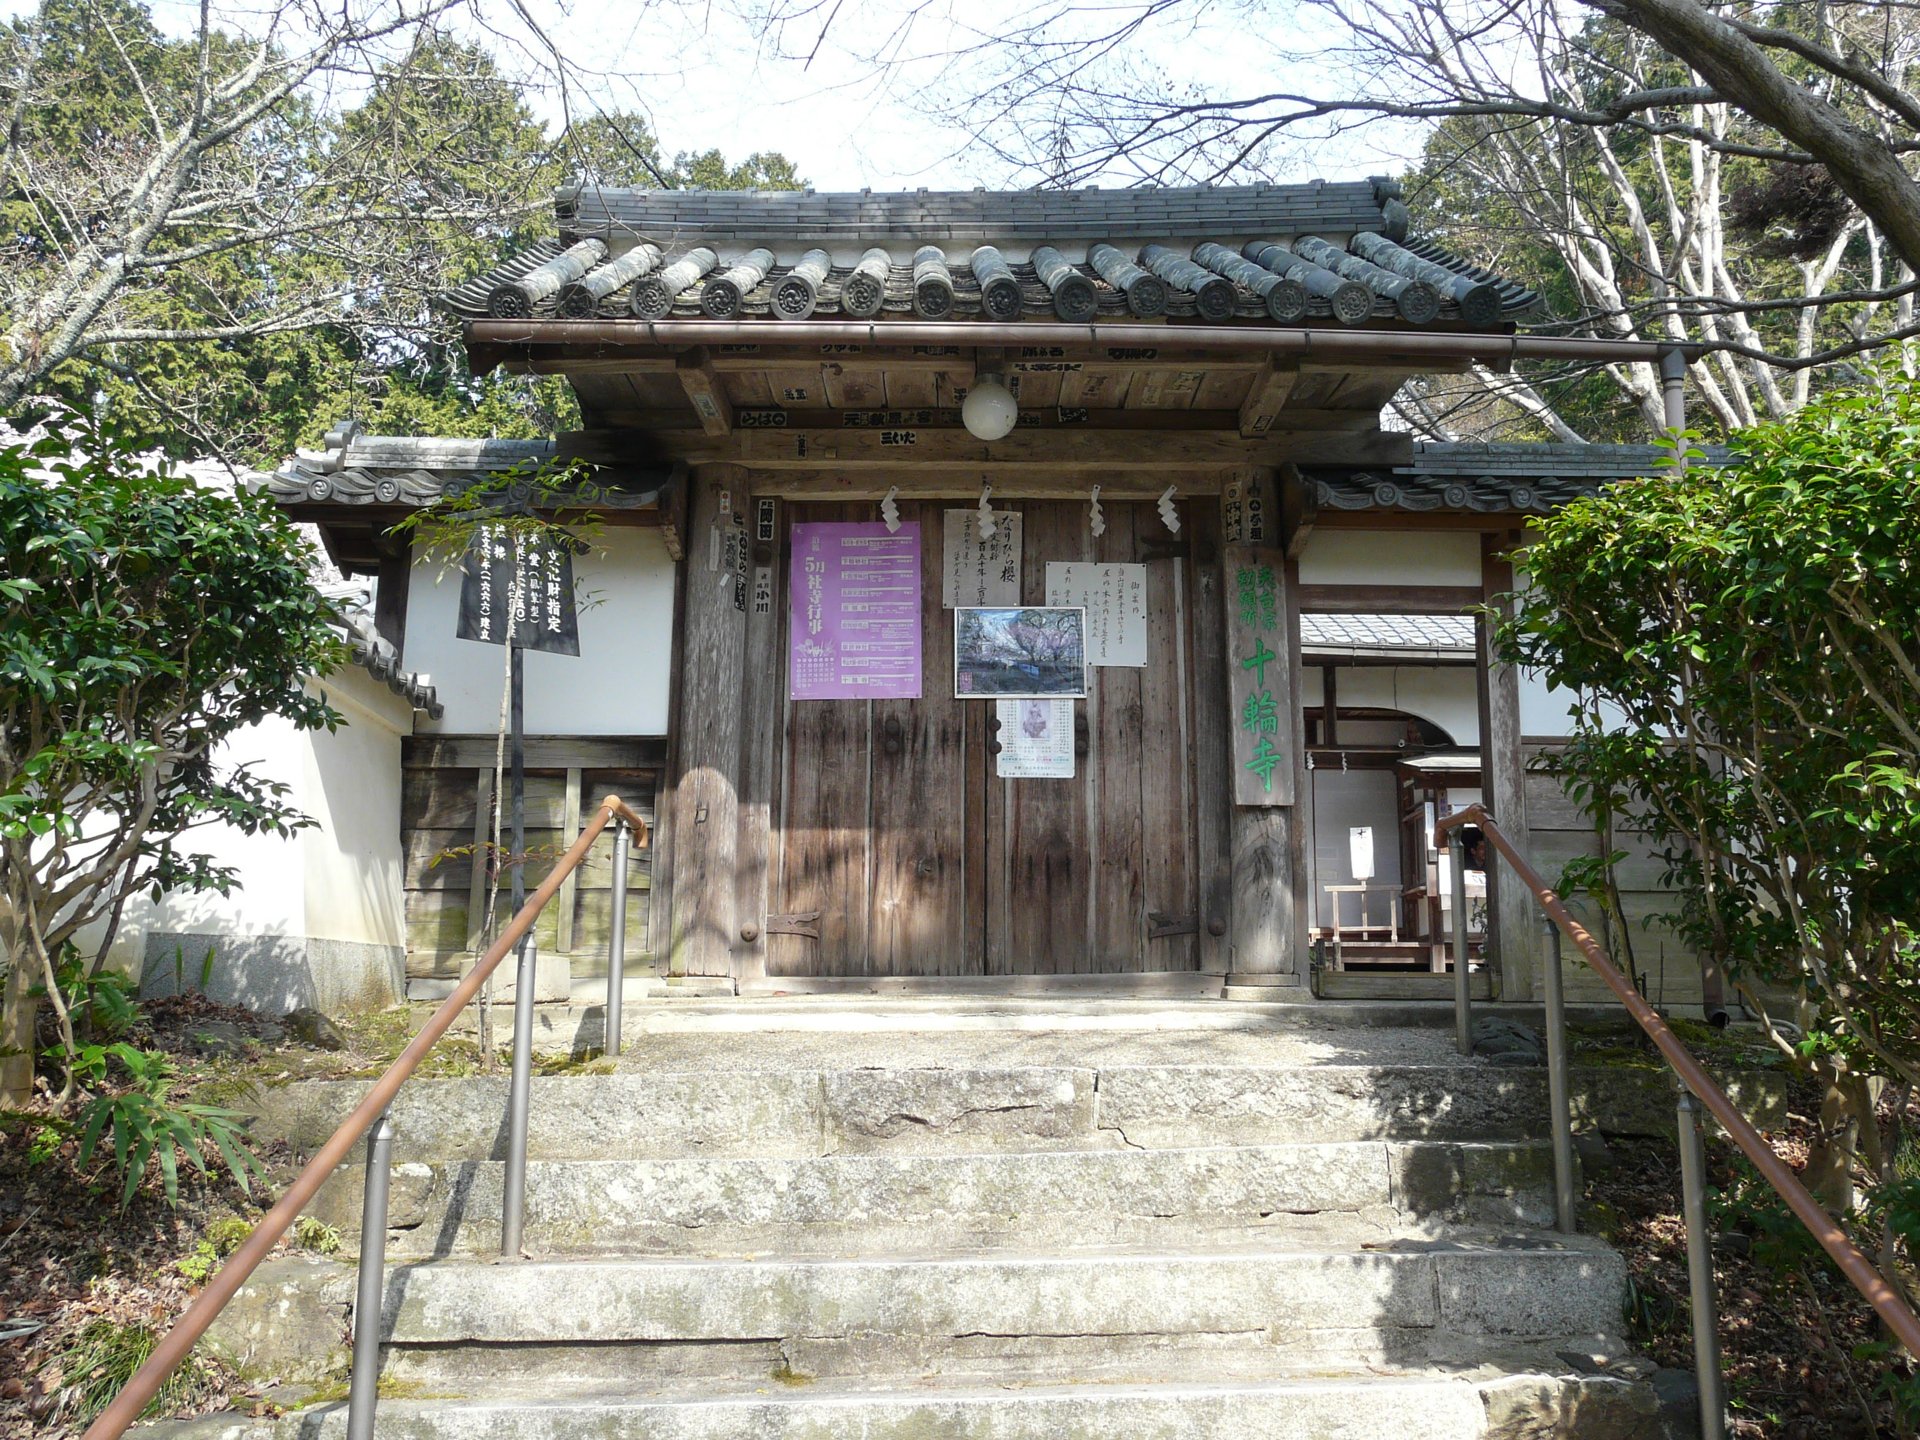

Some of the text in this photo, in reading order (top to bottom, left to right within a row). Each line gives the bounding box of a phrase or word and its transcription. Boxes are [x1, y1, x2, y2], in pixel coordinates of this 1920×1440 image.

[759, 508, 773, 540] 岡田
[756, 590, 770, 613] 小川
[1241, 637, 1281, 794] 十輪寺
